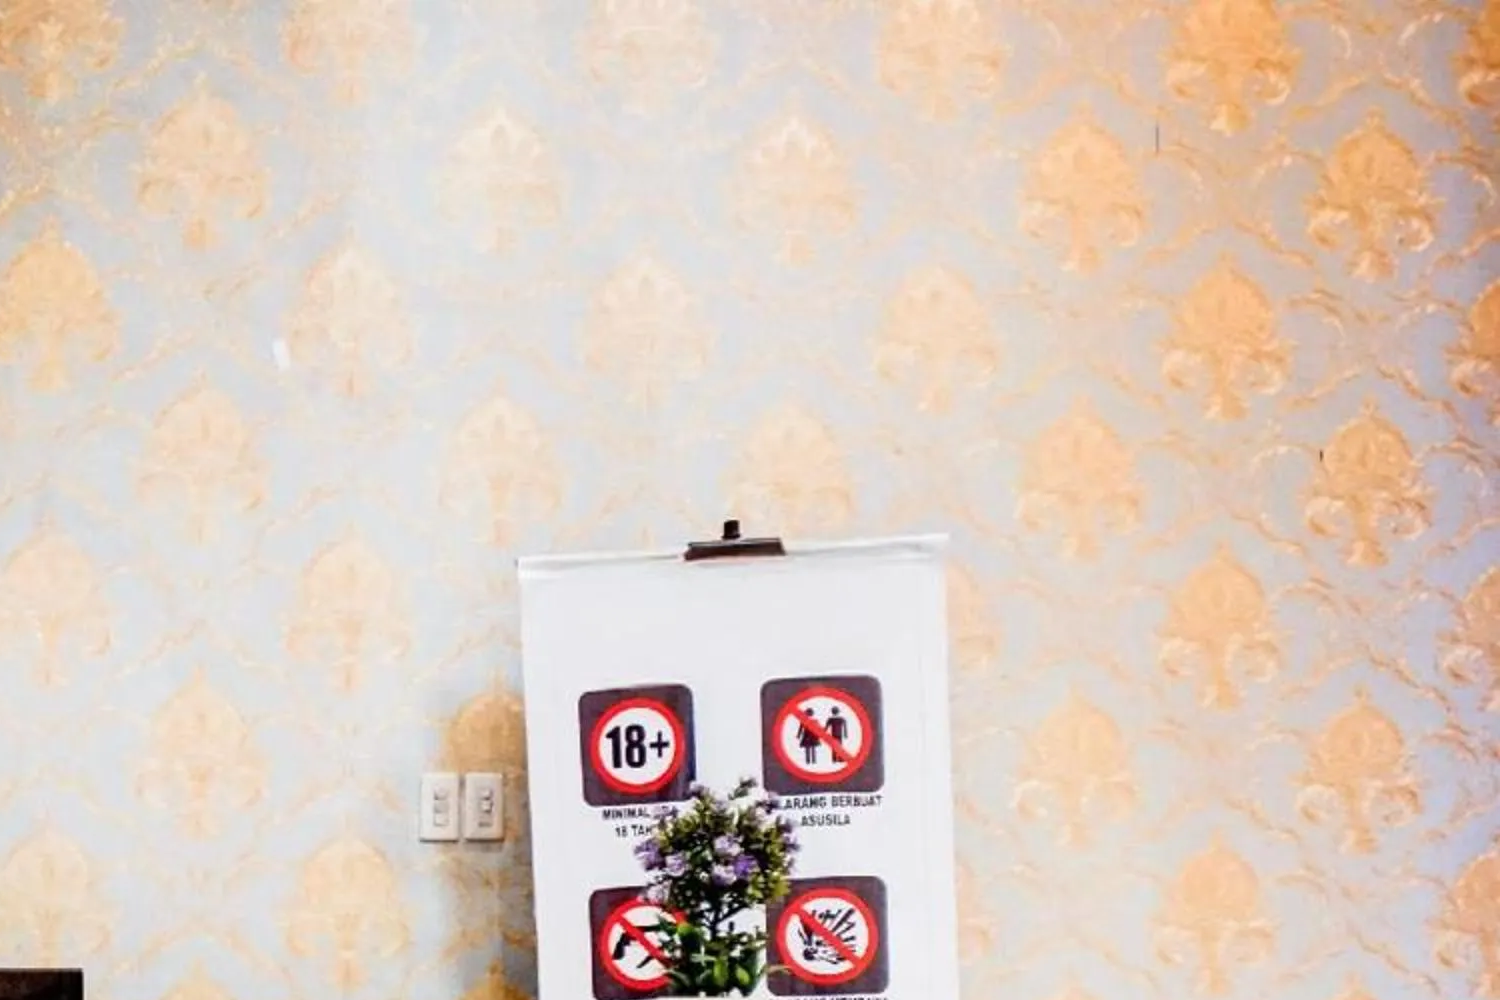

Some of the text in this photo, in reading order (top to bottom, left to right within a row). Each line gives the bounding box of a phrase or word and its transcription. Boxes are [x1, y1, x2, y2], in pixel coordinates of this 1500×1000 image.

[605, 723, 670, 769] 18+
[784, 796, 827, 809] ARANG
[801, 814, 850, 827] ASUSILA
[630, 823, 652, 837] TAH
